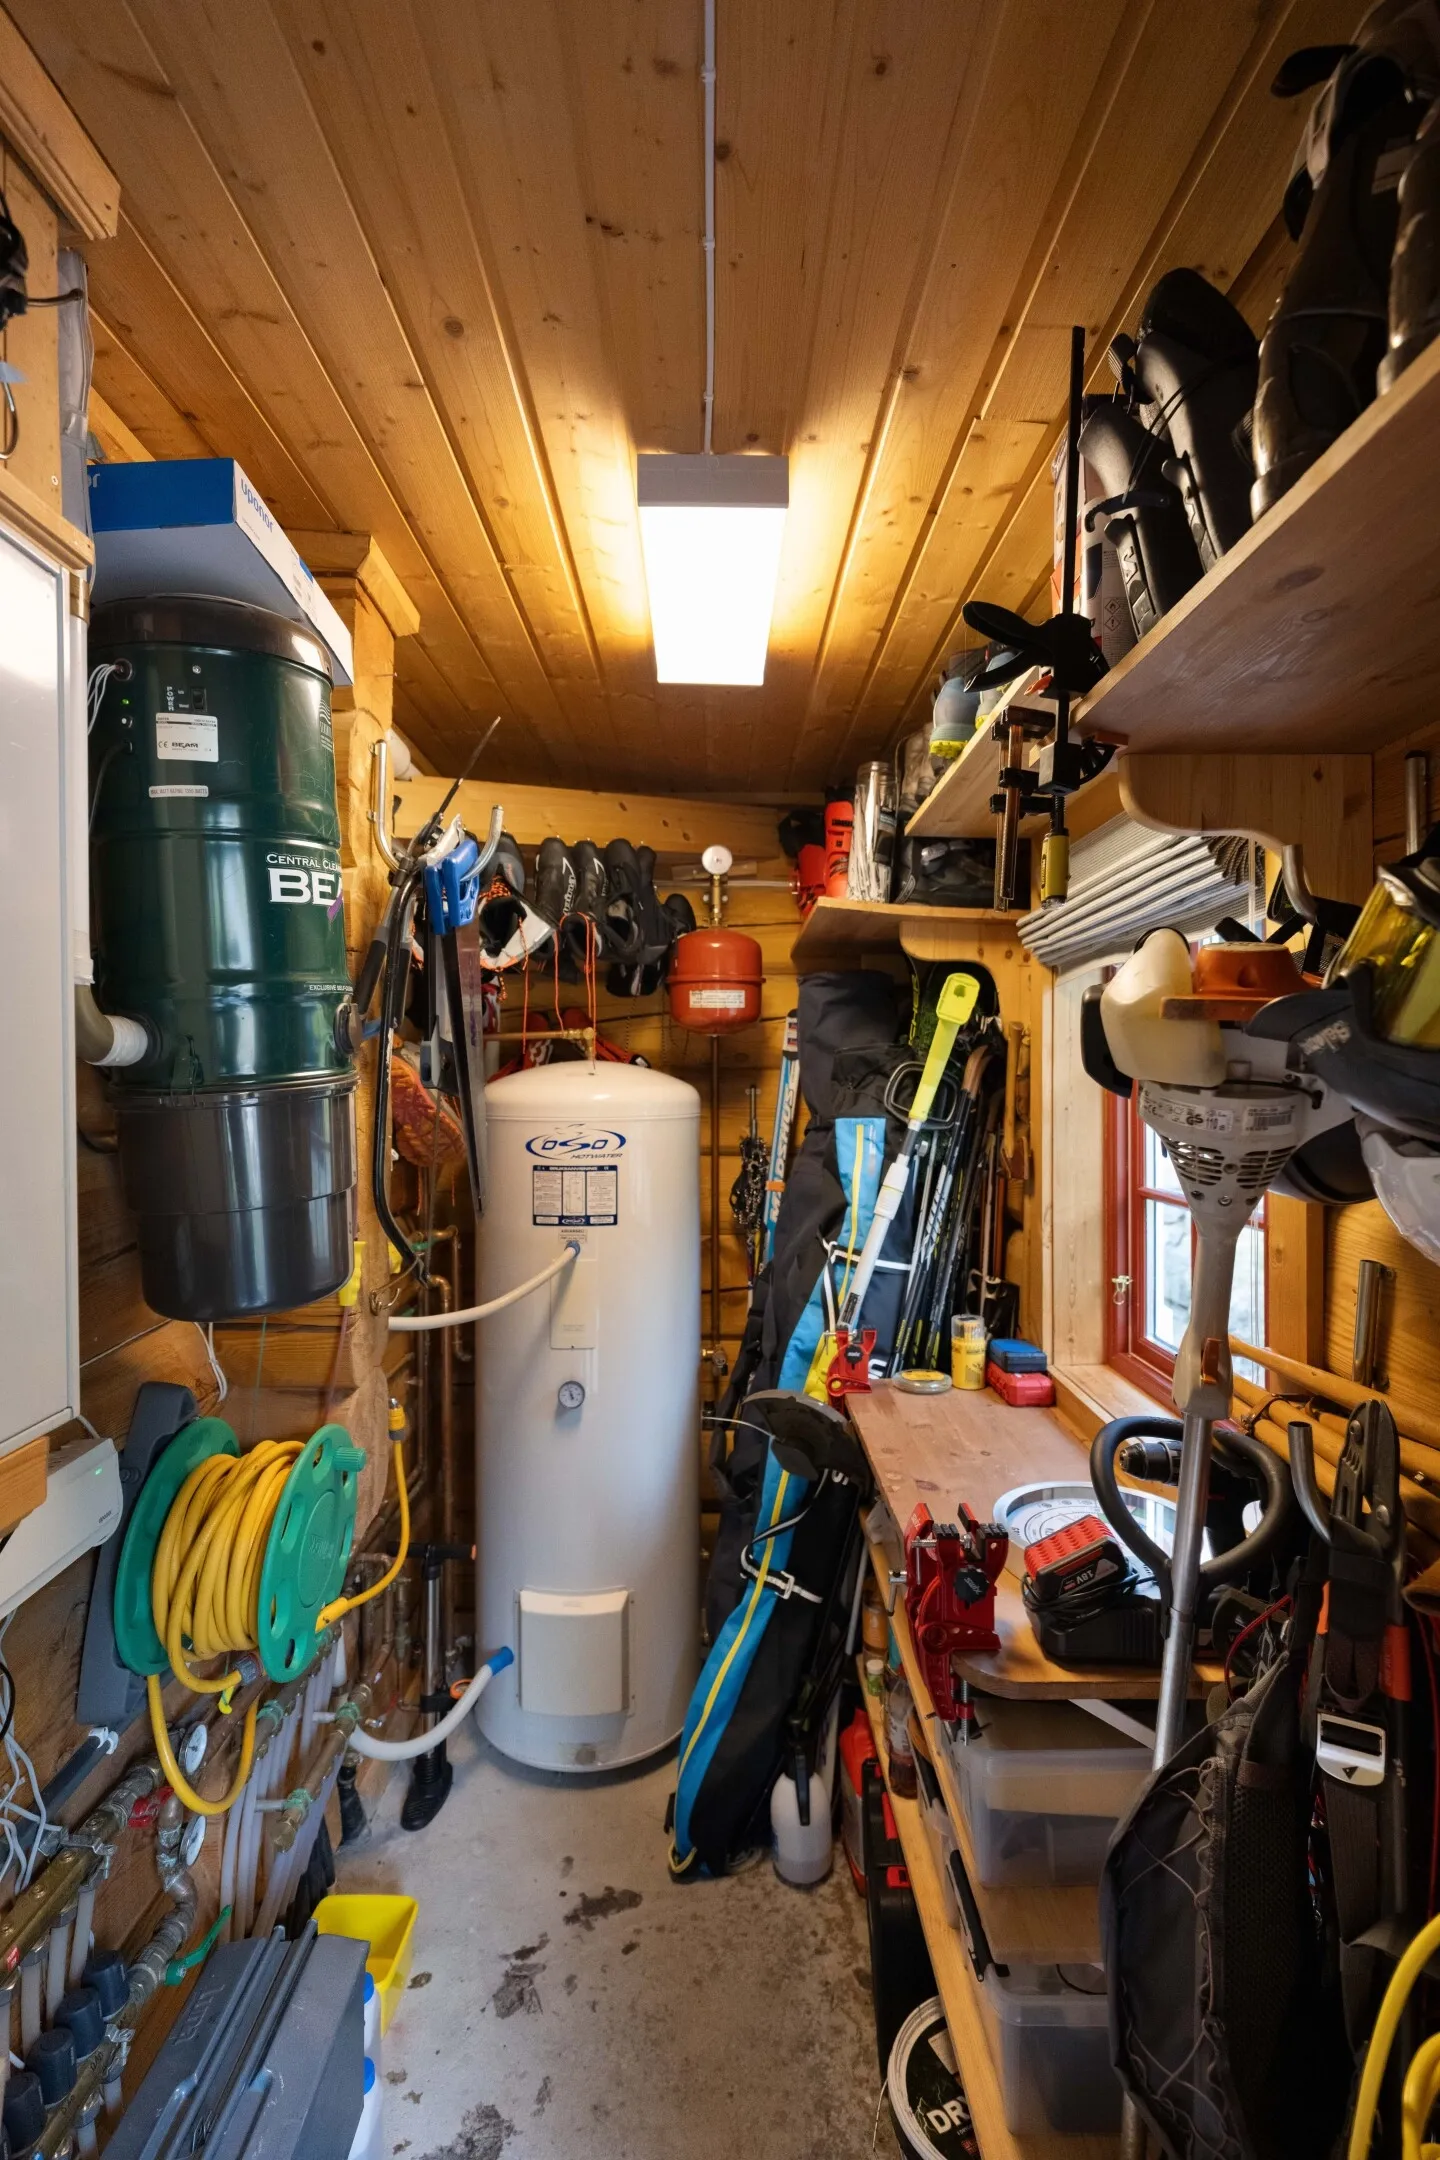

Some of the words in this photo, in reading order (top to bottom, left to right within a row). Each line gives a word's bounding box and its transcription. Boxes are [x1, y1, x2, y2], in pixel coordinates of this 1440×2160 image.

[240, 478, 274, 533] uponor
[166, 686, 174, 711] POWER
[266, 853, 320, 868] CENTRAL
[1075, 1569, 1094, 1585] 18V
